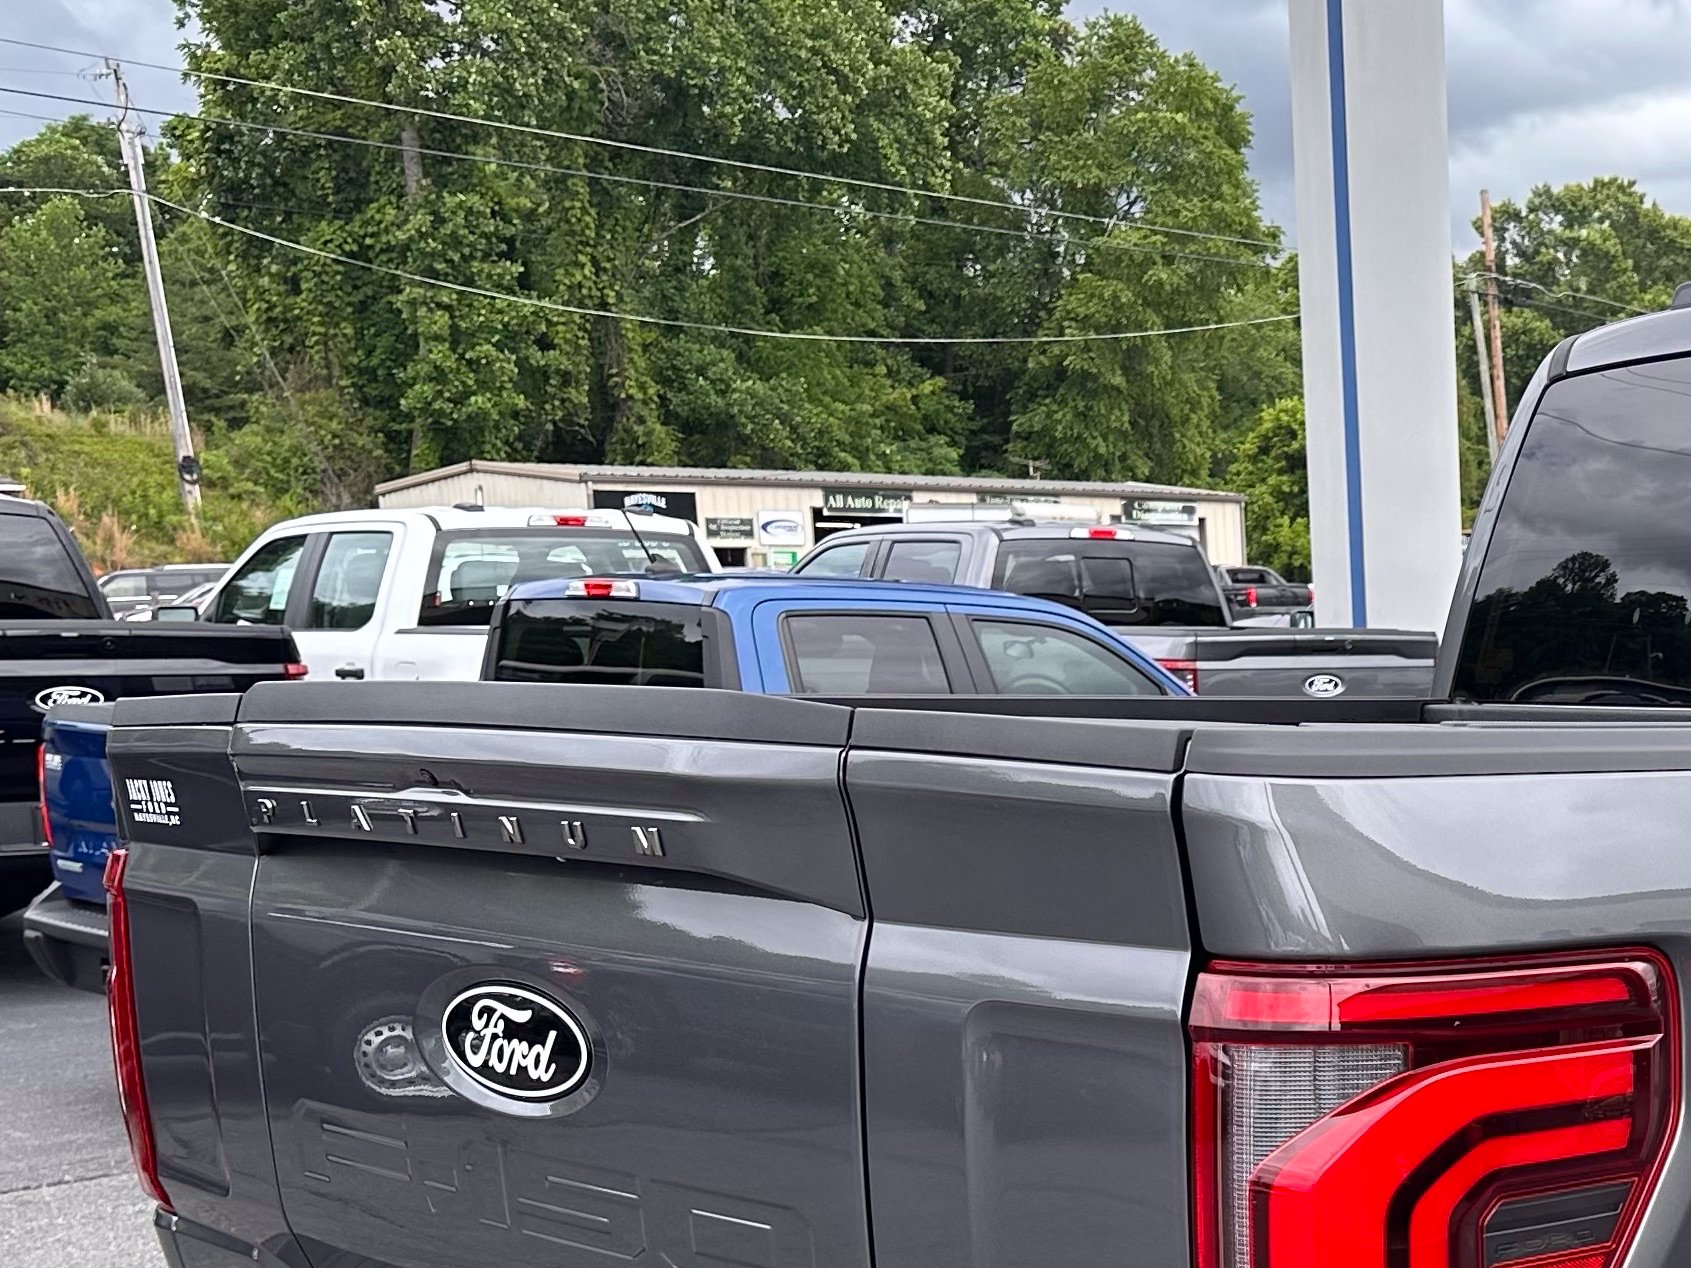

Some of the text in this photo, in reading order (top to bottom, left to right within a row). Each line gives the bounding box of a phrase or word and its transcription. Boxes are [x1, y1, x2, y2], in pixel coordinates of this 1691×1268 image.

[827, 495, 844, 509] All
[846, 495, 873, 509] Auto
[256, 798, 666, 857] PLATINUM
[463, 998, 558, 1084] Ford
